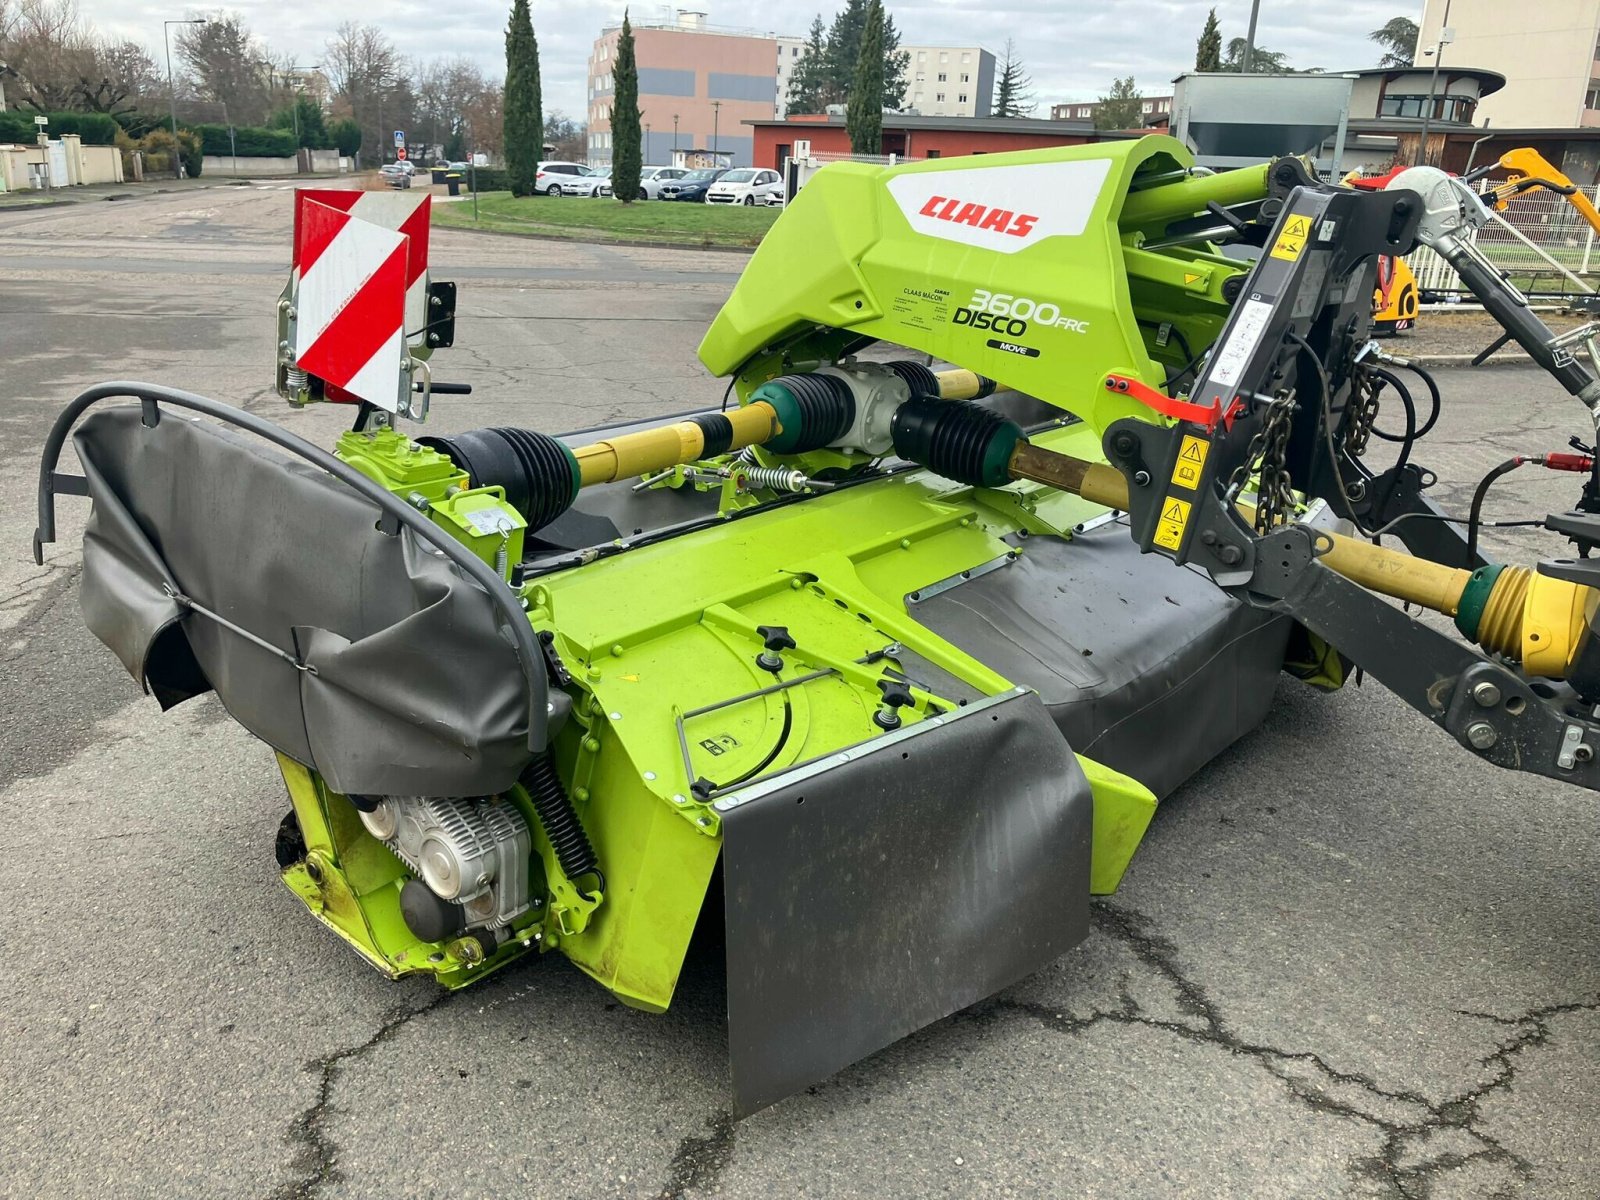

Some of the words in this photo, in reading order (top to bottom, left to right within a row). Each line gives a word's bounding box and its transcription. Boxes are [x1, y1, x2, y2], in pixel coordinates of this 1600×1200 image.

[919, 195, 1039, 238] CLAAS
[903, 287, 922, 297] CLAAS
[952, 307, 1027, 337] DISCO
[1000, 342, 1028, 355] MOVE
